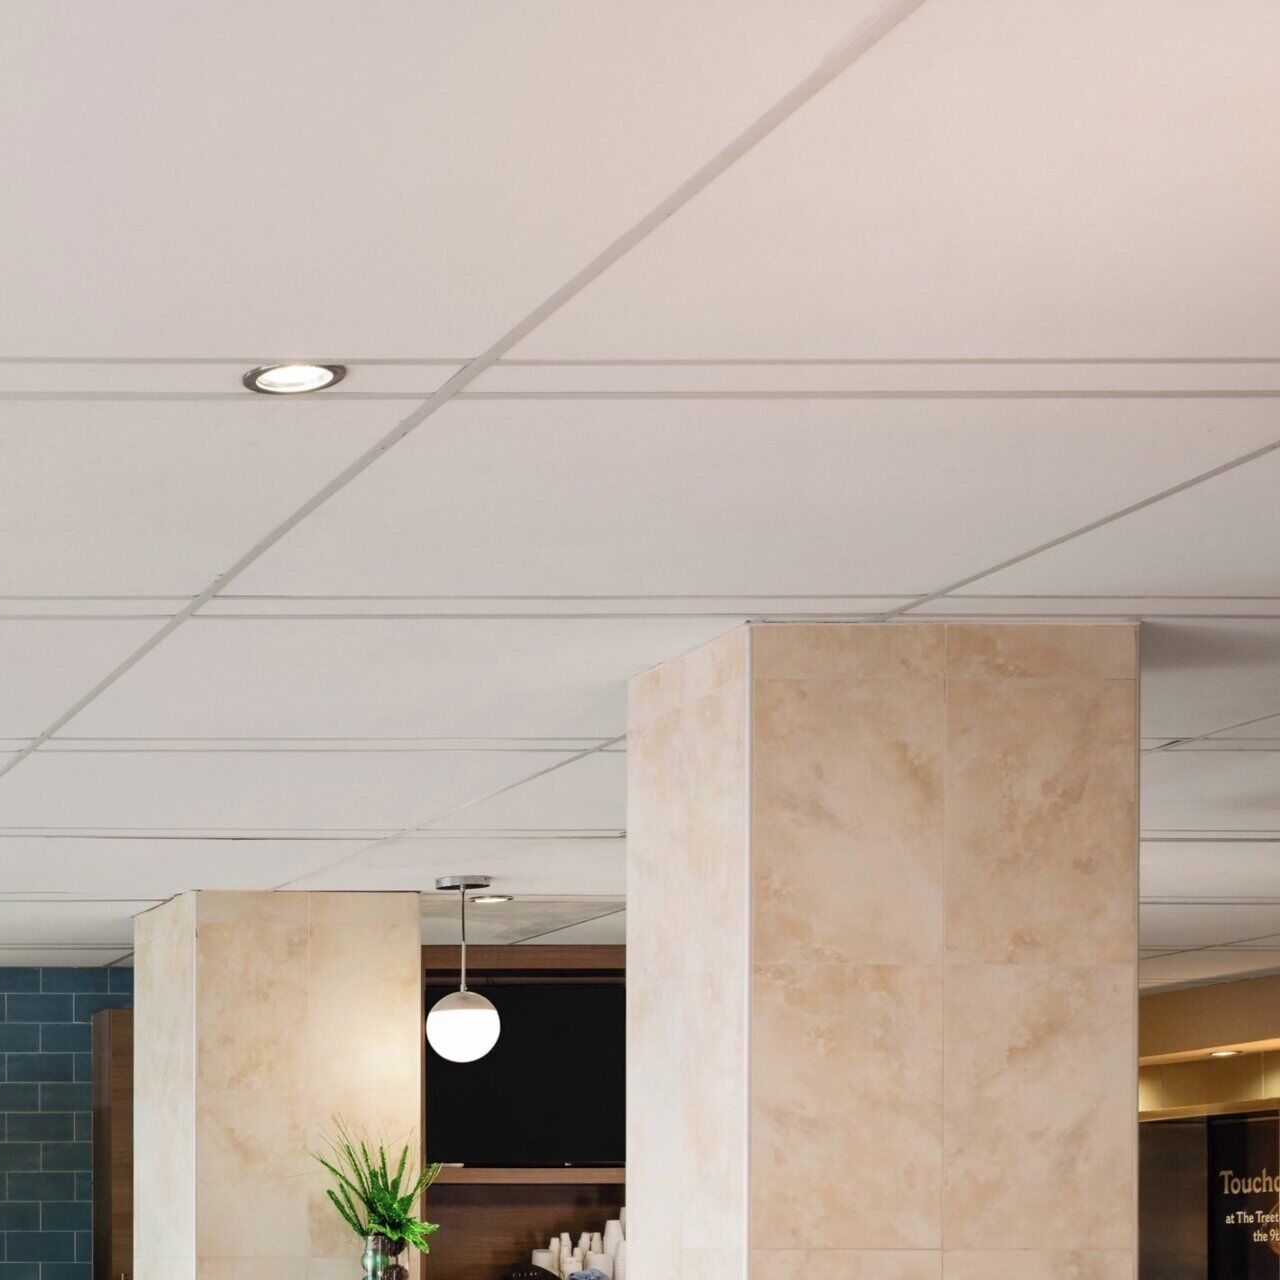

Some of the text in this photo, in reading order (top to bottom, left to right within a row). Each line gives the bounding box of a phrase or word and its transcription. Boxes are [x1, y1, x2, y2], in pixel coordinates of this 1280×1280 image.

[1225, 1213, 1235, 1224] at
[1236, 1211, 1254, 1223] The
[1252, 1230, 1268, 1242] the
